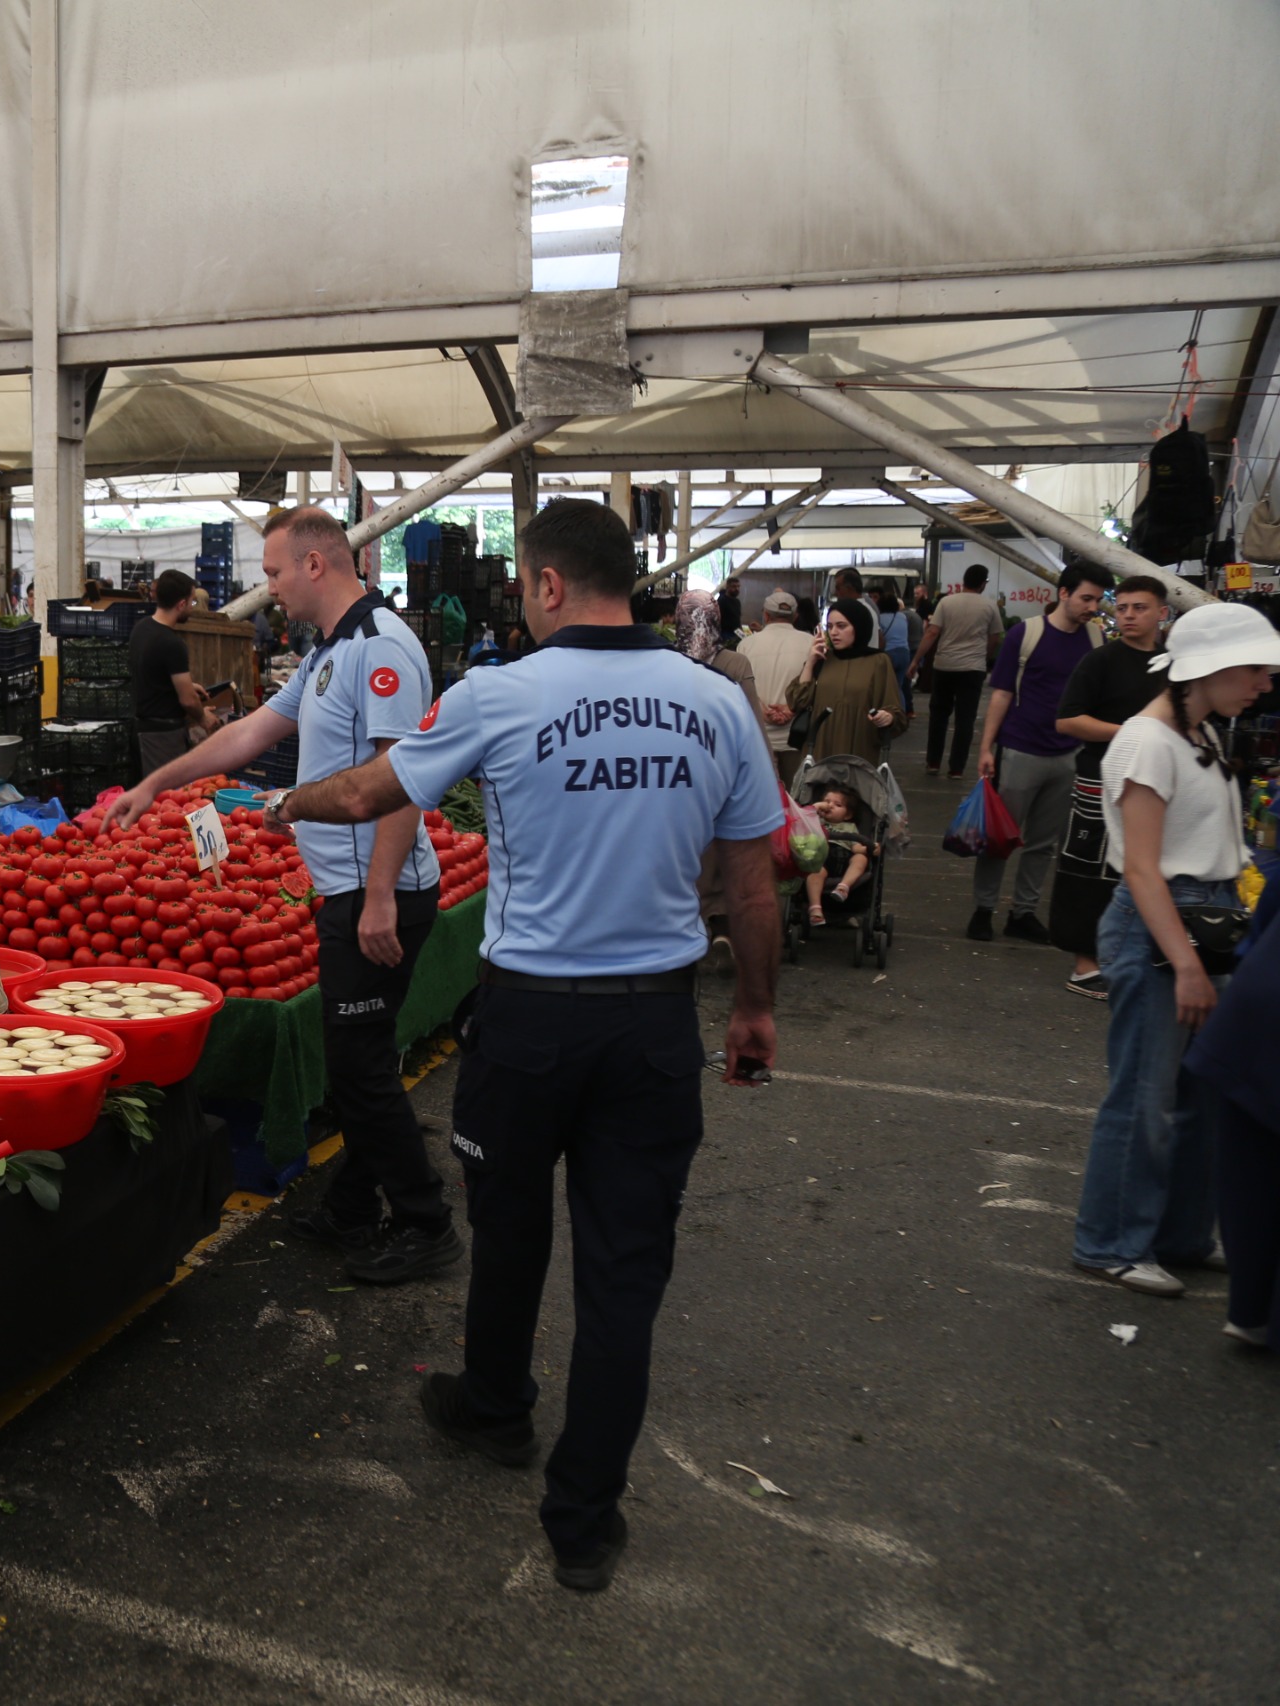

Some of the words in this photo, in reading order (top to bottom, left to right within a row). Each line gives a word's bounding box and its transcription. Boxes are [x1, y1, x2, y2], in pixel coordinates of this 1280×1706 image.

[537, 697, 716, 764] EYÜPSULTAN
[564, 755, 693, 792] ZABITA
[338, 998, 386, 1015] ZABITA
